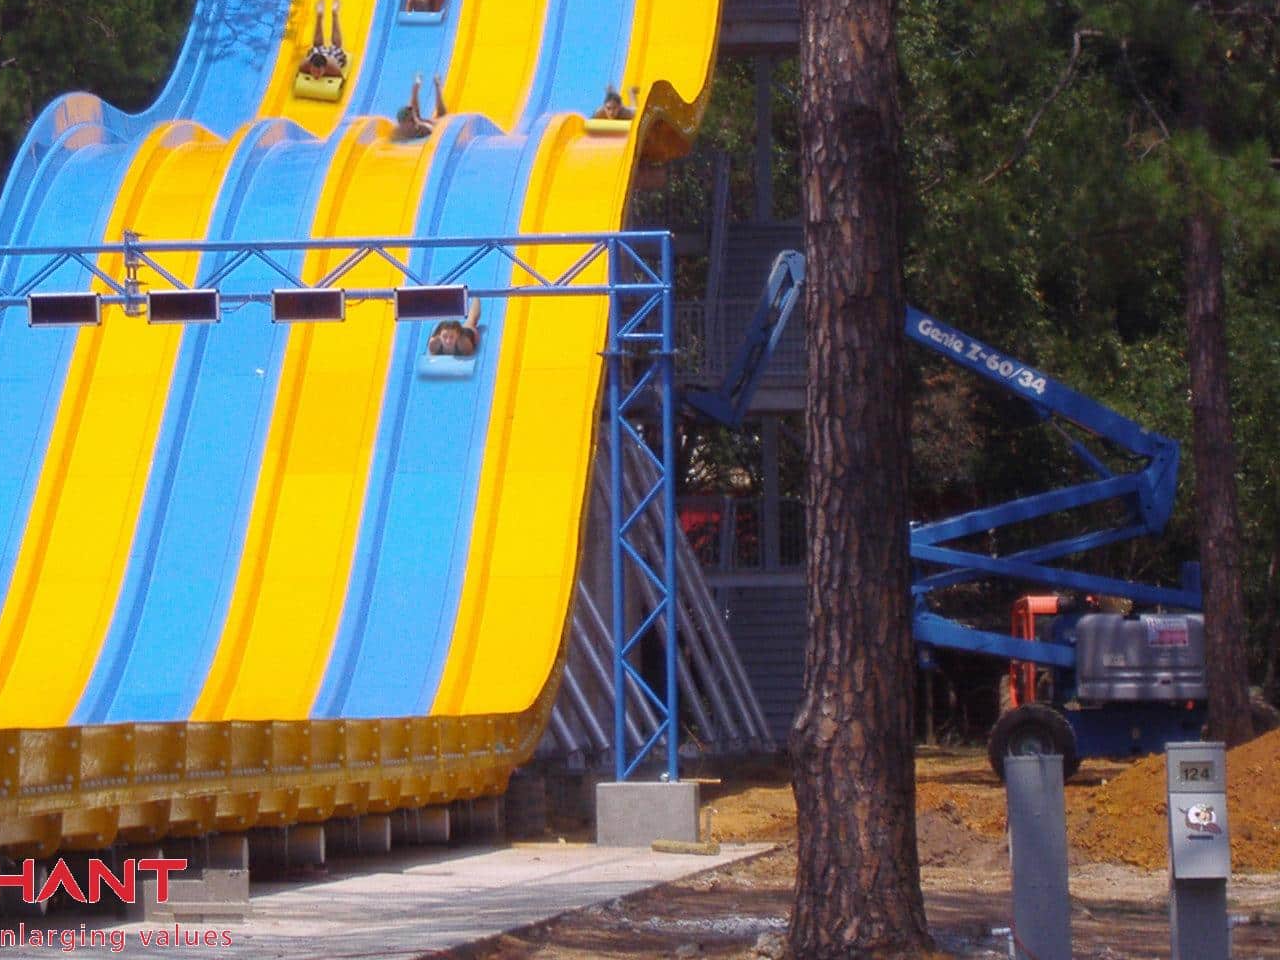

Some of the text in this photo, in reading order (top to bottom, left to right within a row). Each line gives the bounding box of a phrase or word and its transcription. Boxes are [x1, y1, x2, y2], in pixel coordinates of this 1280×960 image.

[918, 319, 1046, 394] Genie Z-60/34
[1183, 767, 1210, 781] 124
